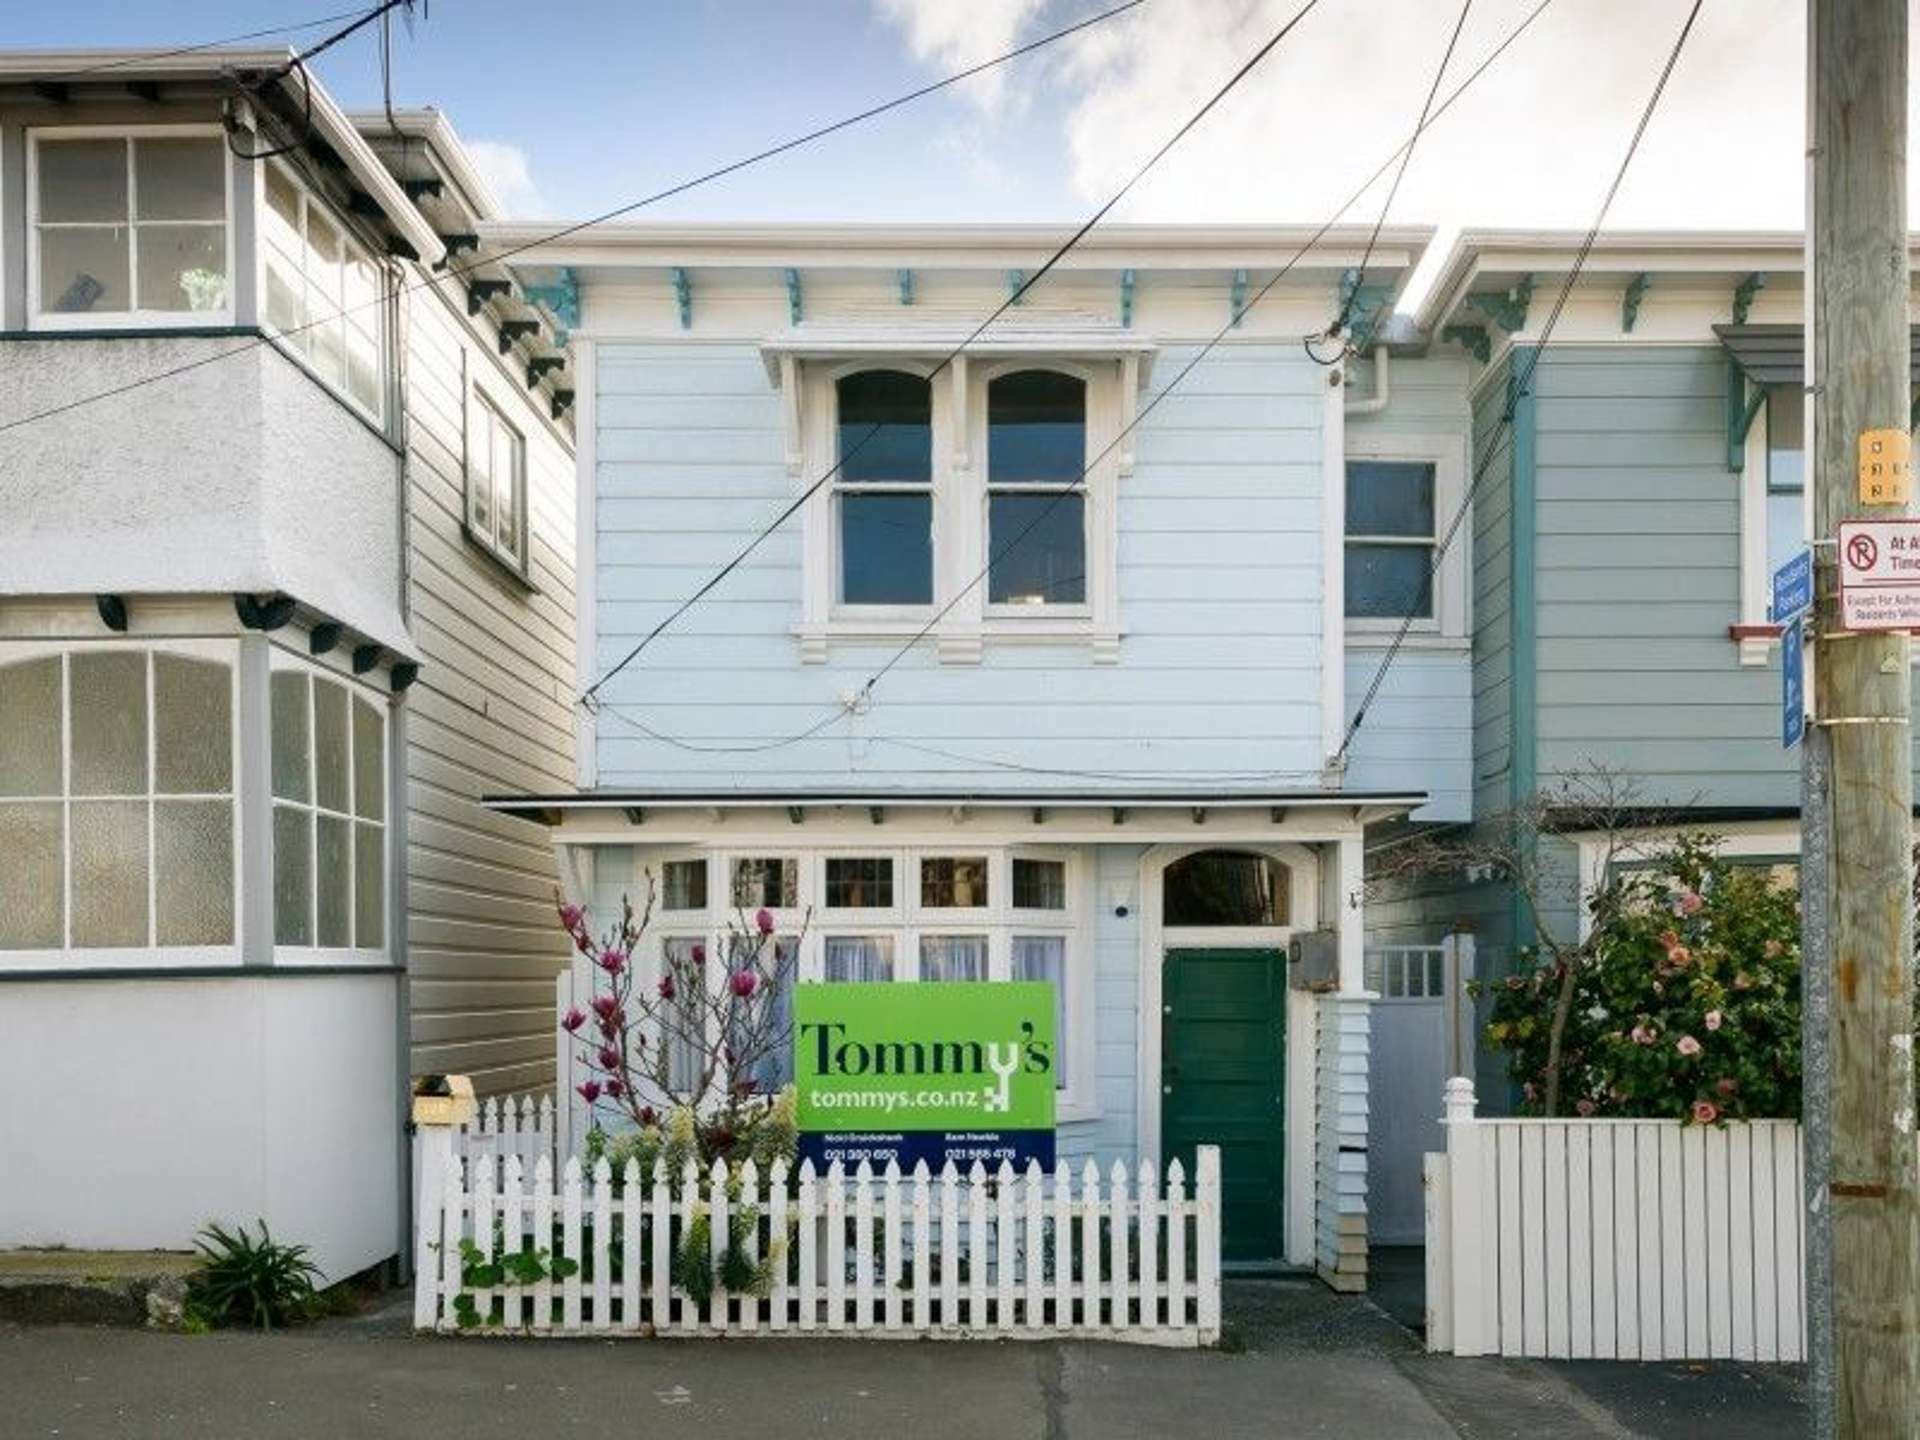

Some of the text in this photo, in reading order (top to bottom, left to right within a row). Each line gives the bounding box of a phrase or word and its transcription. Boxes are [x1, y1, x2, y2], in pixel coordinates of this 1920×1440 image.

[1890, 536, 1905, 550] At
[800, 1022, 1051, 1112] Tommy's
[811, 1090, 978, 1113] tommys.co.nz
